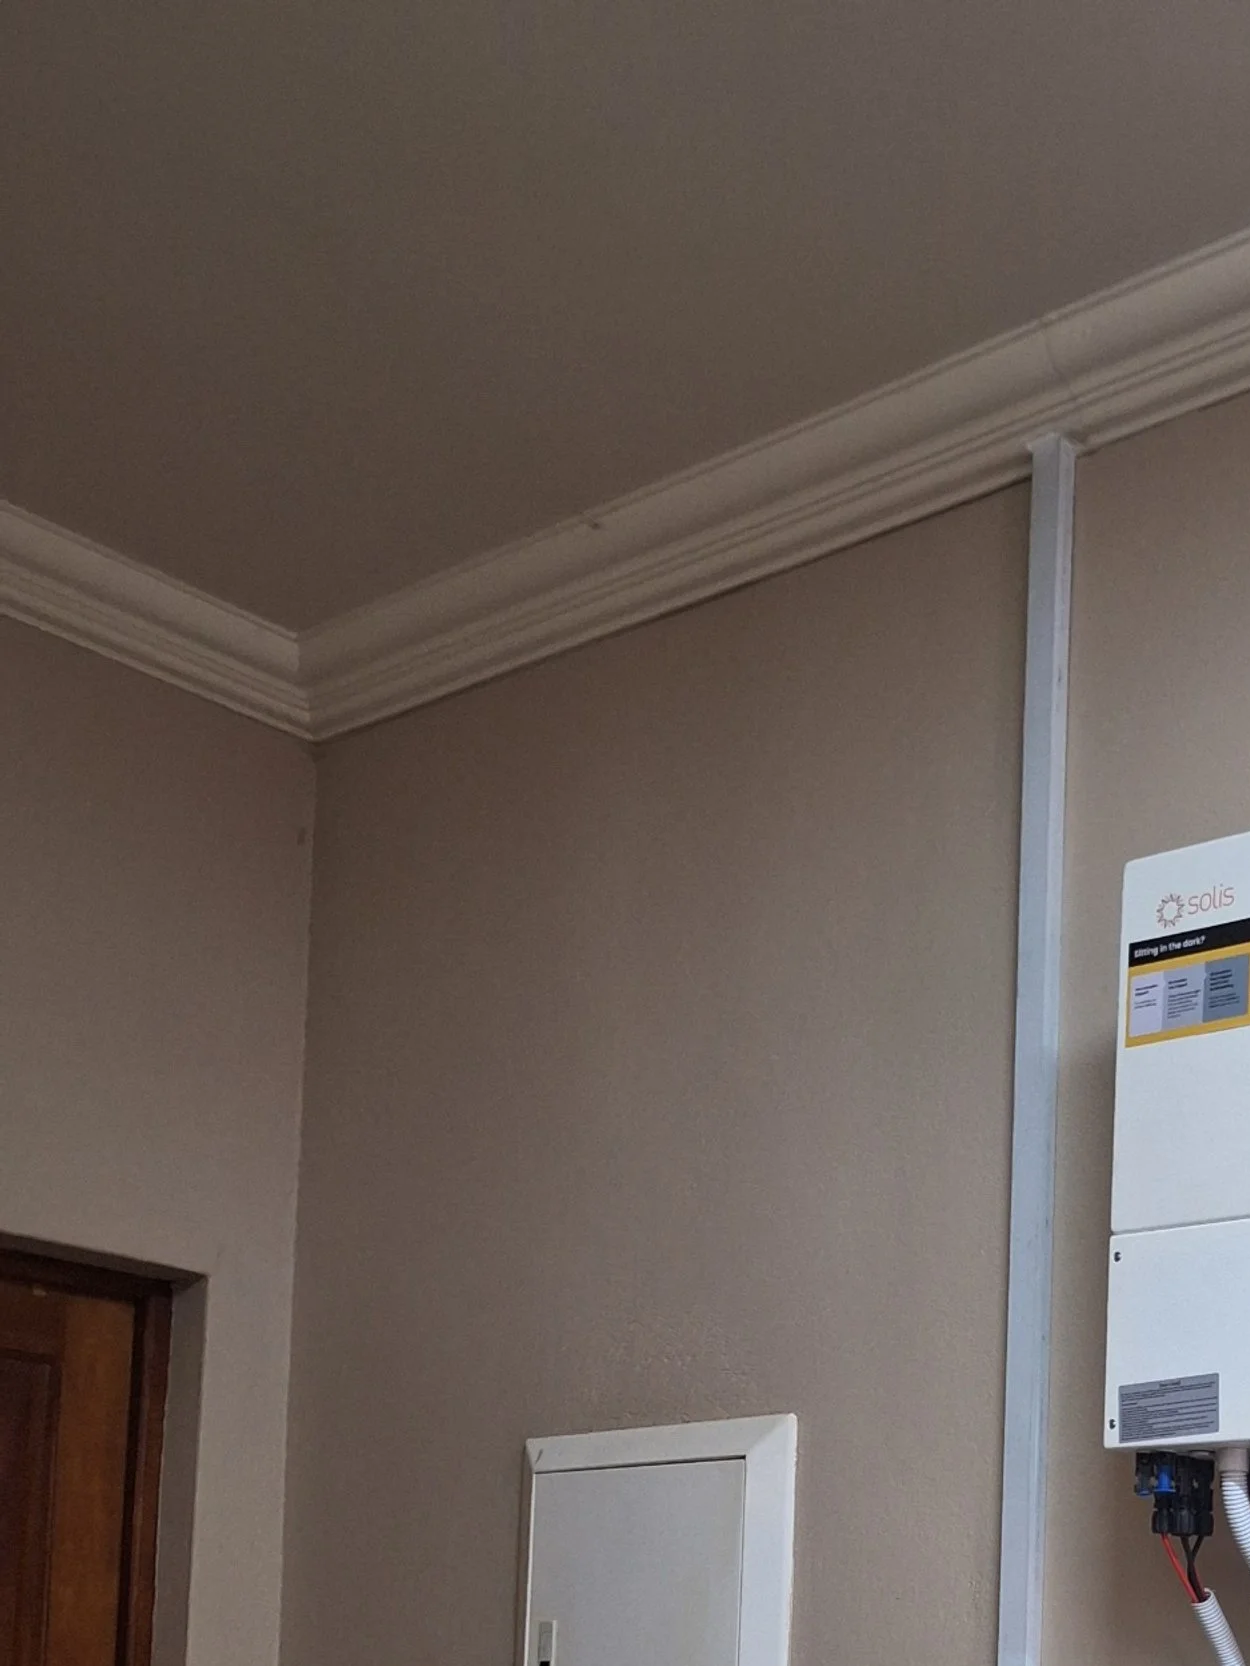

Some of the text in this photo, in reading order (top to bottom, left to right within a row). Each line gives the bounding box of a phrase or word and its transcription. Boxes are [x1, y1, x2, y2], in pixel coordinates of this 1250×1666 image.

[1188, 884, 1235, 915] solis
[1160, 944, 1168, 953] in
[1168, 942, 1182, 951] the
[1183, 935, 1206, 948] dark?
